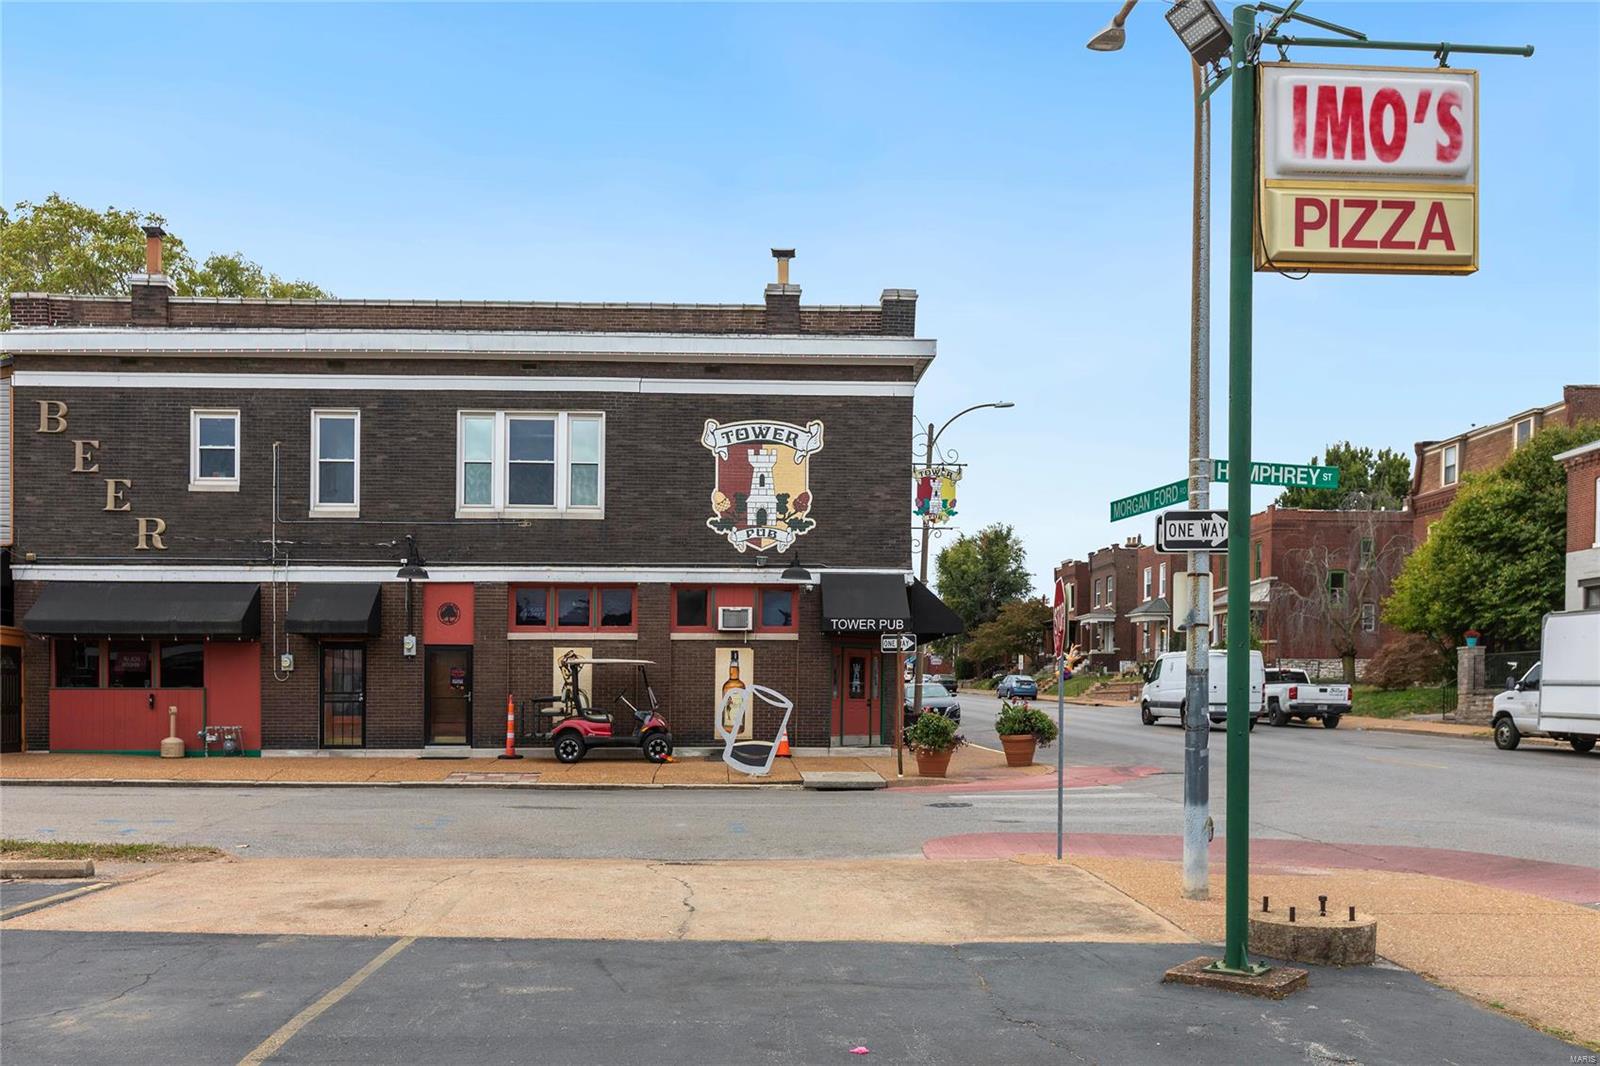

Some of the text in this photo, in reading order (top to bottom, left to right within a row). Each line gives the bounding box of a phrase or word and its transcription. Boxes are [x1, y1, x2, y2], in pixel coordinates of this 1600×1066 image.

[1292, 84, 1464, 164] IMO'S
[1294, 197, 1456, 251] PIZZA
[721, 426, 799, 447] TOWER
[36, 399, 168, 550] BEER
[1217, 462, 1333, 486] HMPHREY ST
[1113, 493, 1150, 519] MORGAN
[1154, 485, 1178, 508] FORD
[746, 528, 777, 539] PUB
[1169, 523, 1226, 537] ONE WAY
[831, 619, 904, 630] TOWER PUB
